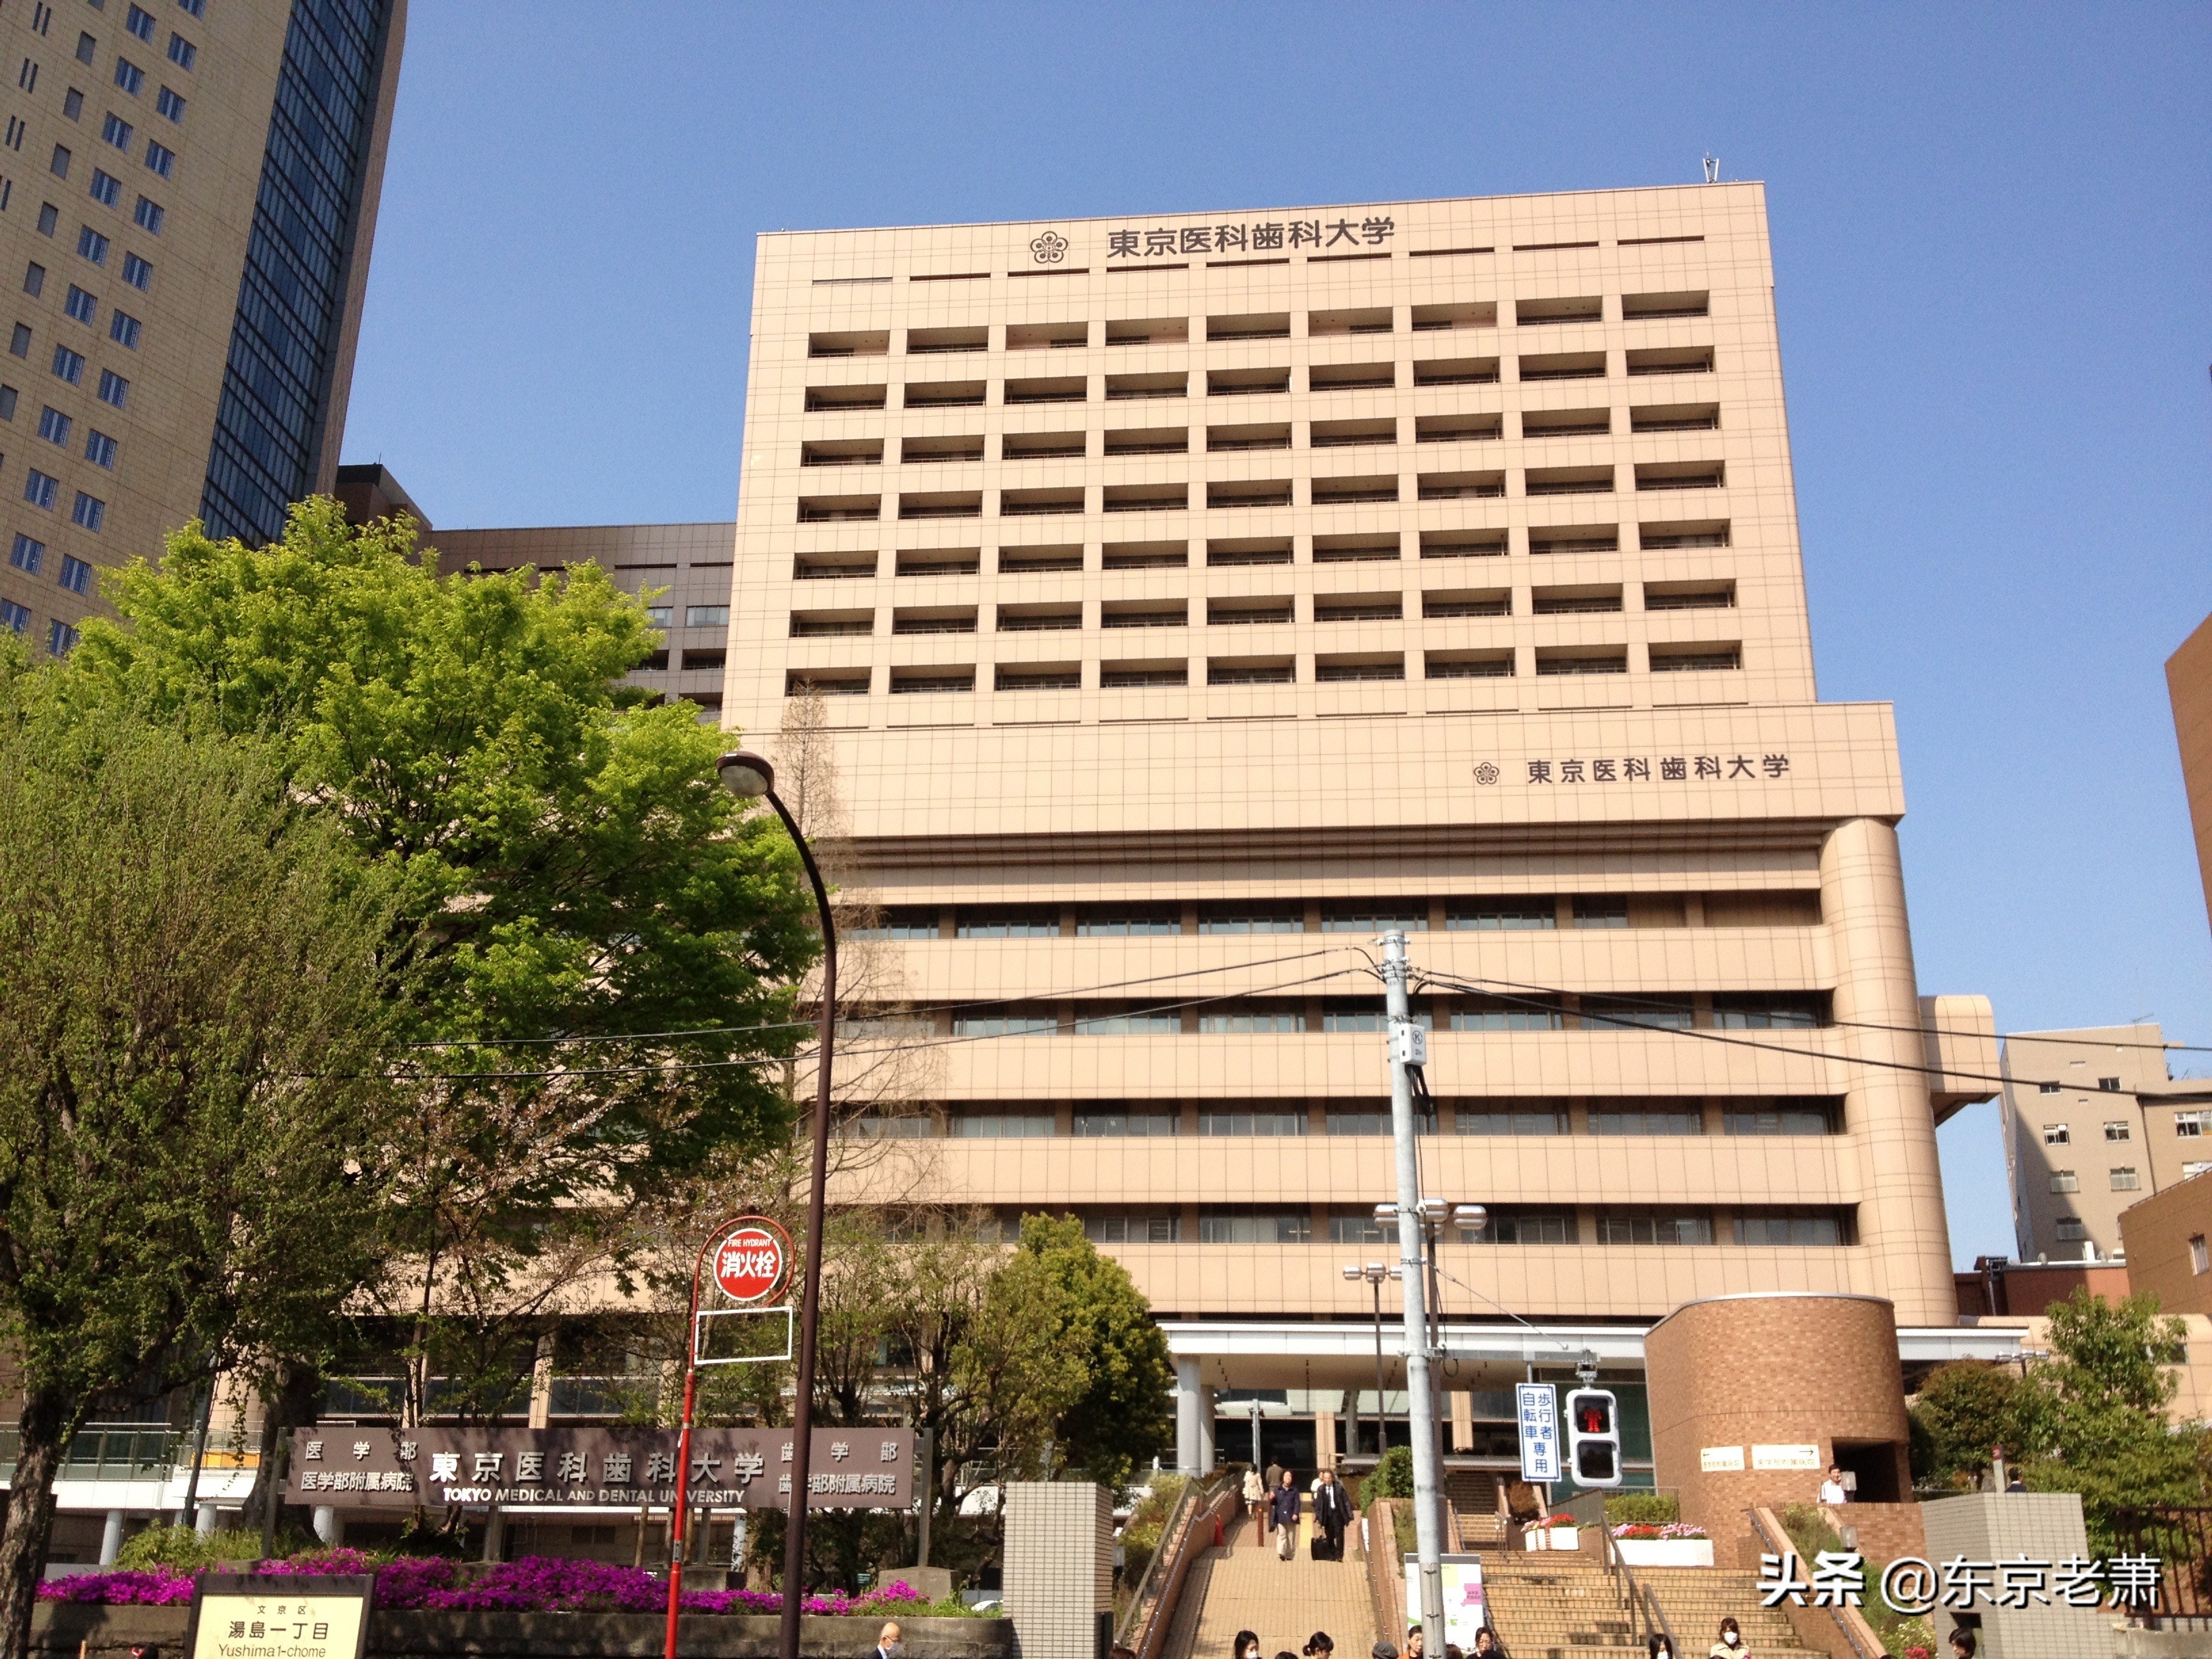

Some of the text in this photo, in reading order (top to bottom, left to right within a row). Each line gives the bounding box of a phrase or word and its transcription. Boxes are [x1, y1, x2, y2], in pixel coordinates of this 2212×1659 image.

[1107, 217, 1395, 258] 東京医科歯科大学
[1527, 754, 1789, 784] 東京医科歯科大学
[727, 1237, 772, 1247] FIRE HYDRANT
[720, 1251, 776, 1277] 消火栓
[1523, 1392, 1538, 1439] 自転車
[1538, 1393, 1553, 1440] 歩行者
[305, 1441, 417, 1460] 医学部
[1533, 1442, 1548, 1473] 専用
[429, 1451, 764, 1483] 東京医科歯科大学
[301, 1471, 413, 1492] 医学部附属病院
[779, 1473, 896, 1495] 歯部附属病院
[443, 1488, 745, 1503] TOKYO MEDICAL AND DENTAL UNVERSITY
[257, 1605, 307, 1615] 文京区
[228, 1620, 329, 1640] 湯島一丁目
